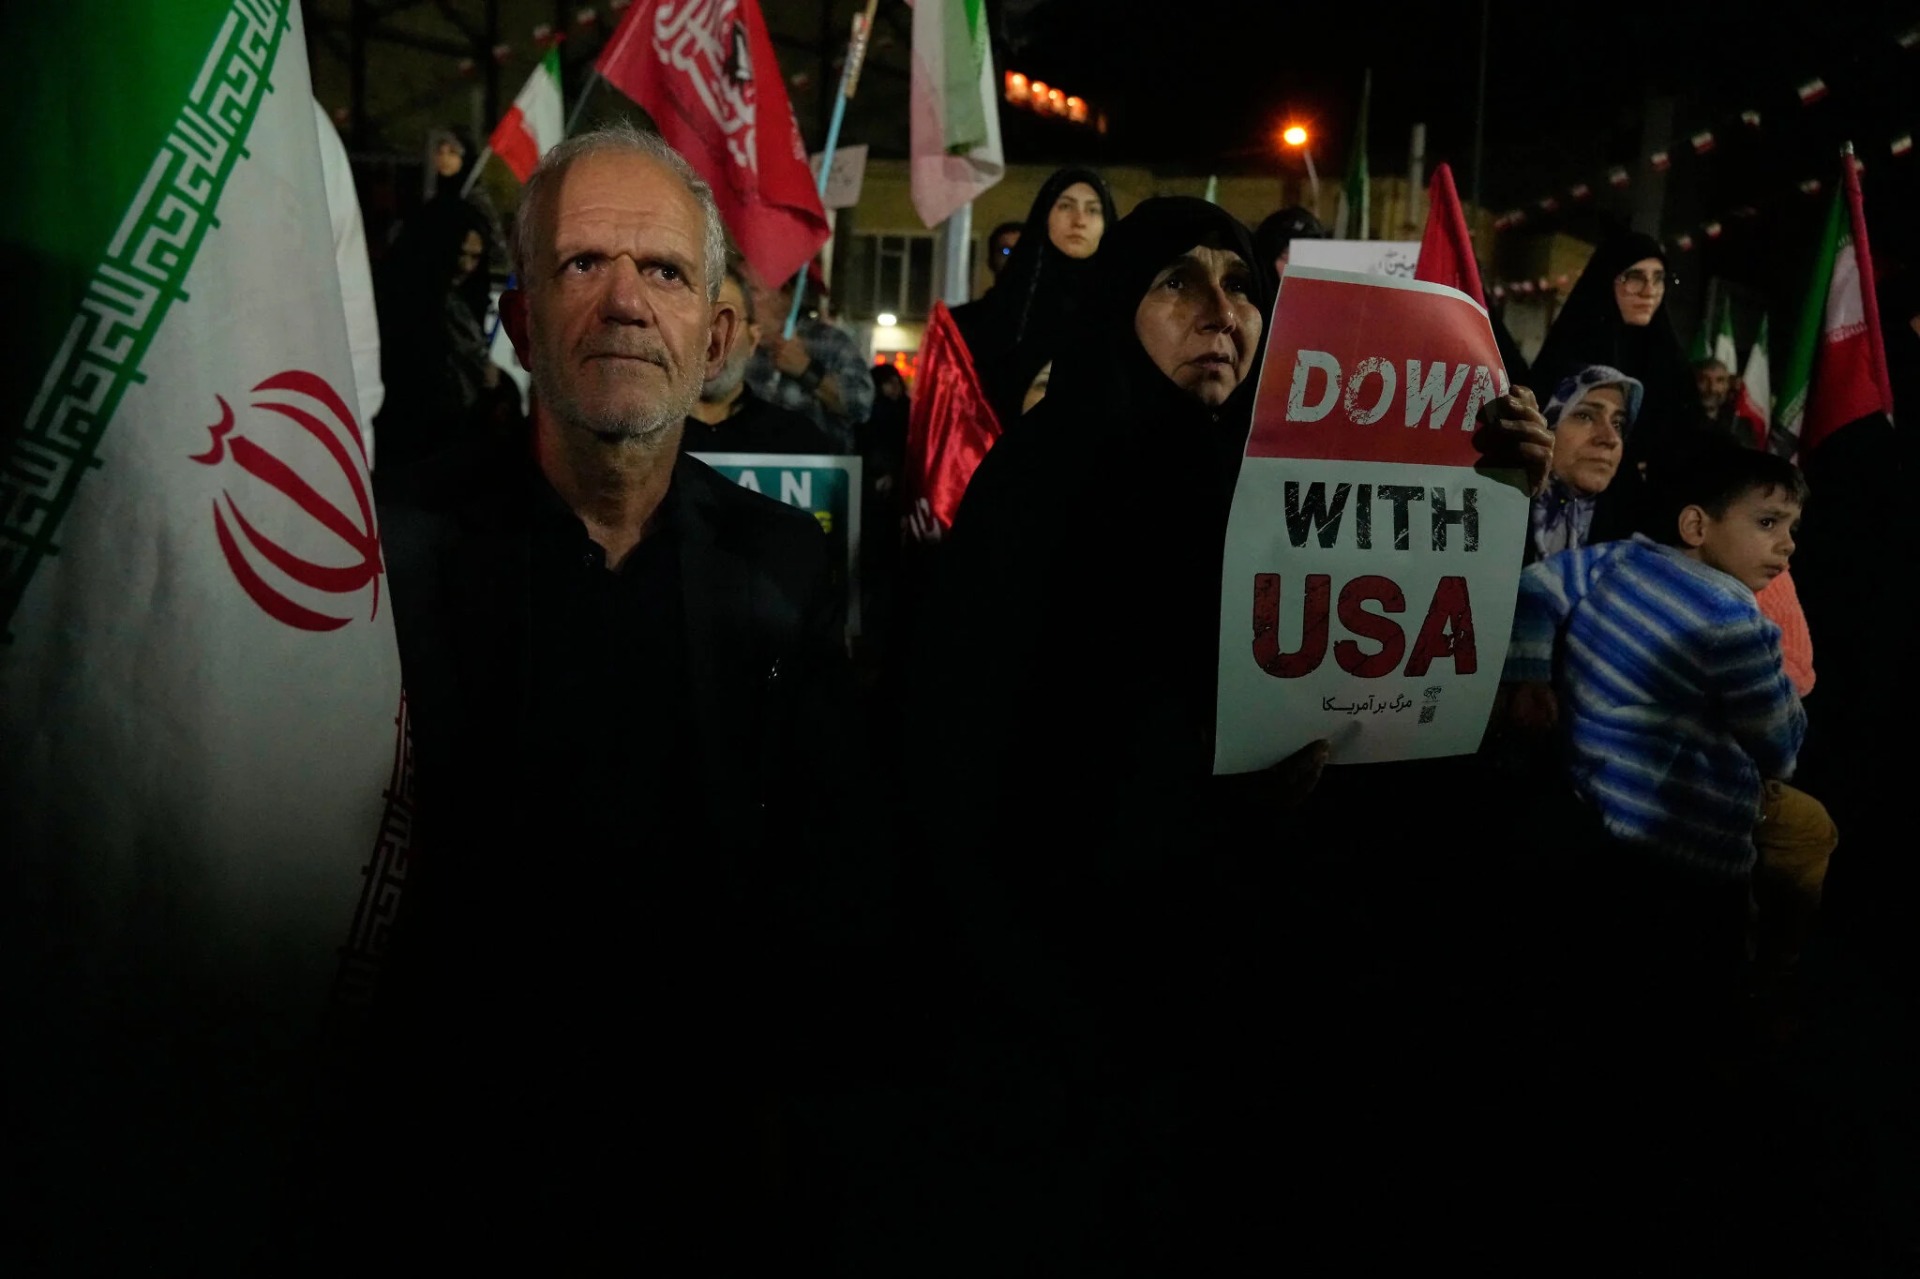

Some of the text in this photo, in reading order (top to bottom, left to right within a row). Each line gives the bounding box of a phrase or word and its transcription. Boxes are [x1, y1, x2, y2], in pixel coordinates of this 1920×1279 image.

[1285, 350, 1511, 432] DOWN
[1284, 481, 1479, 552] WITH
[1253, 573, 1477, 678] USA
[1372, 701, 1387, 714] بر
[1389, 693, 1412, 713] مرگ
